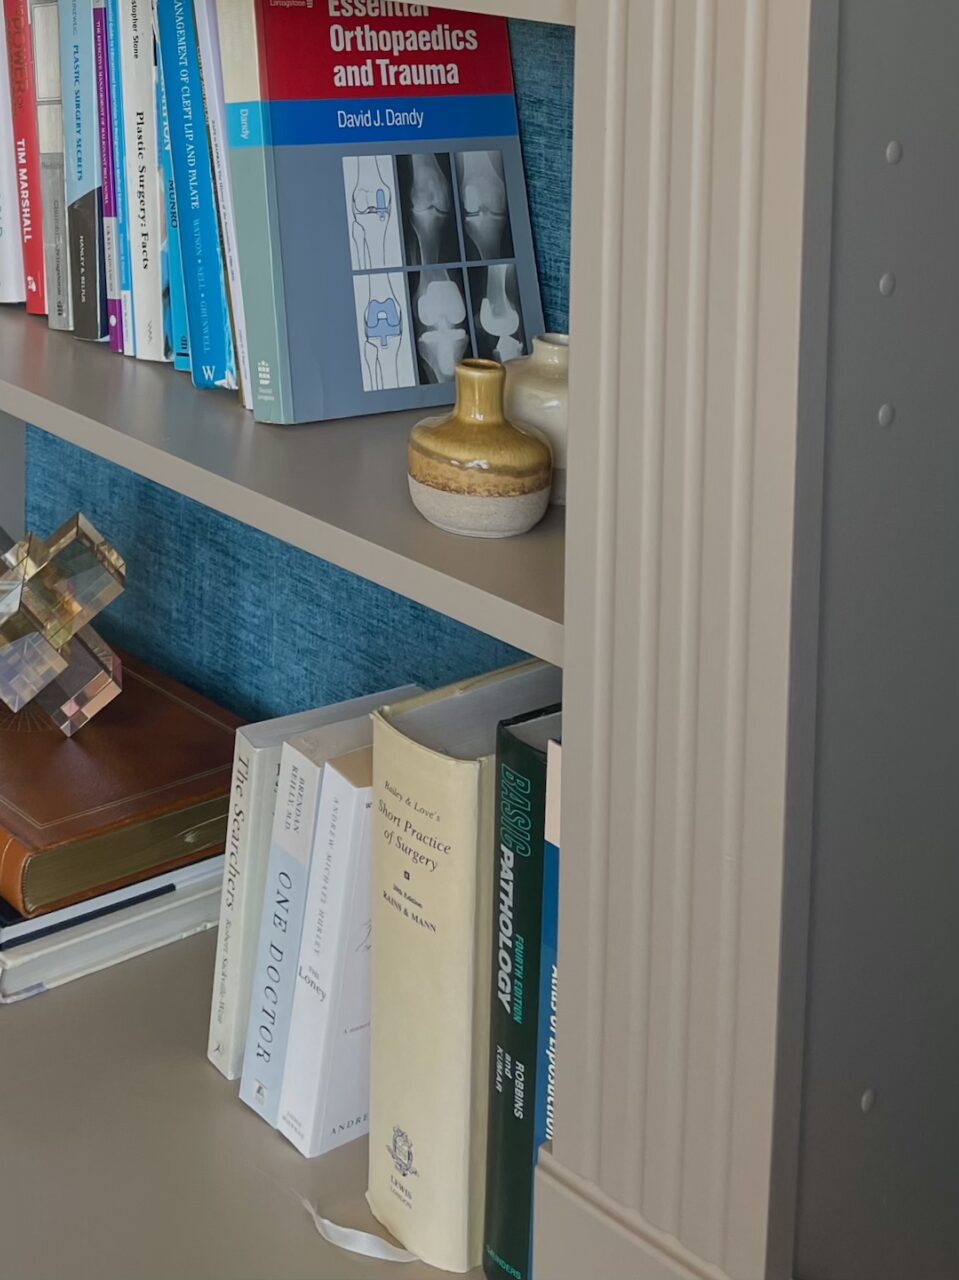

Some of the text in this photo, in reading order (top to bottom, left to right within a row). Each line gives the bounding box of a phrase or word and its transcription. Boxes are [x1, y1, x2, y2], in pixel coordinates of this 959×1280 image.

[9, 16, 28, 92] POWER
[330, 24, 479, 57] Orthopaedics
[178, 67, 190, 85] OF
[333, 58, 460, 87] and Trauma
[72, 44, 84, 182] PLASTIC SURGERY SECRETS
[179, 86, 192, 120] CLEFT
[240, 108, 249, 140] Dandy
[337, 108, 424, 129] David J. Dandy
[136, 111, 147, 159] Plastic
[183, 120, 194, 141] LIP
[185, 142, 196, 169] AND
[16, 138, 33, 244] TIM MARSHALL
[168, 179, 180, 229] MUNRO
[188, 170, 200, 210] PALATE
[141, 231, 150, 270] Facts
[191, 218, 202, 257] WATSON
[196, 266, 207, 291] SELL
[198, 300, 212, 354] GRUNWELL
[201, 365, 216, 381] W
[292, 777, 306, 833] BRENDAN
[377, 799, 452, 855] Short Practice
[404, 796, 412, 808] &
[414, 801, 441, 823] Love's
[500, 763, 532, 858] BASIC
[225, 754, 250, 912] The Searchers
[383, 827, 439, 873] of Surgery
[314, 796, 341, 957] ANDREW MICHAEL HURLEY
[383, 889, 437, 934] RAINS & MANN
[497, 843, 515, 1014] PATHOLOGY
[256, 871, 294, 1064] ONE DOCTOR
[298, 966, 327, 1003] Loney
[513, 933, 525, 1024] FOURTH EDITION
[494, 1044, 504, 1093] KUMAR
[504, 1052, 513, 1080] and
[513, 1060, 525, 1120] ROBBINS
[389, 1175, 413, 1201] LEWIS
